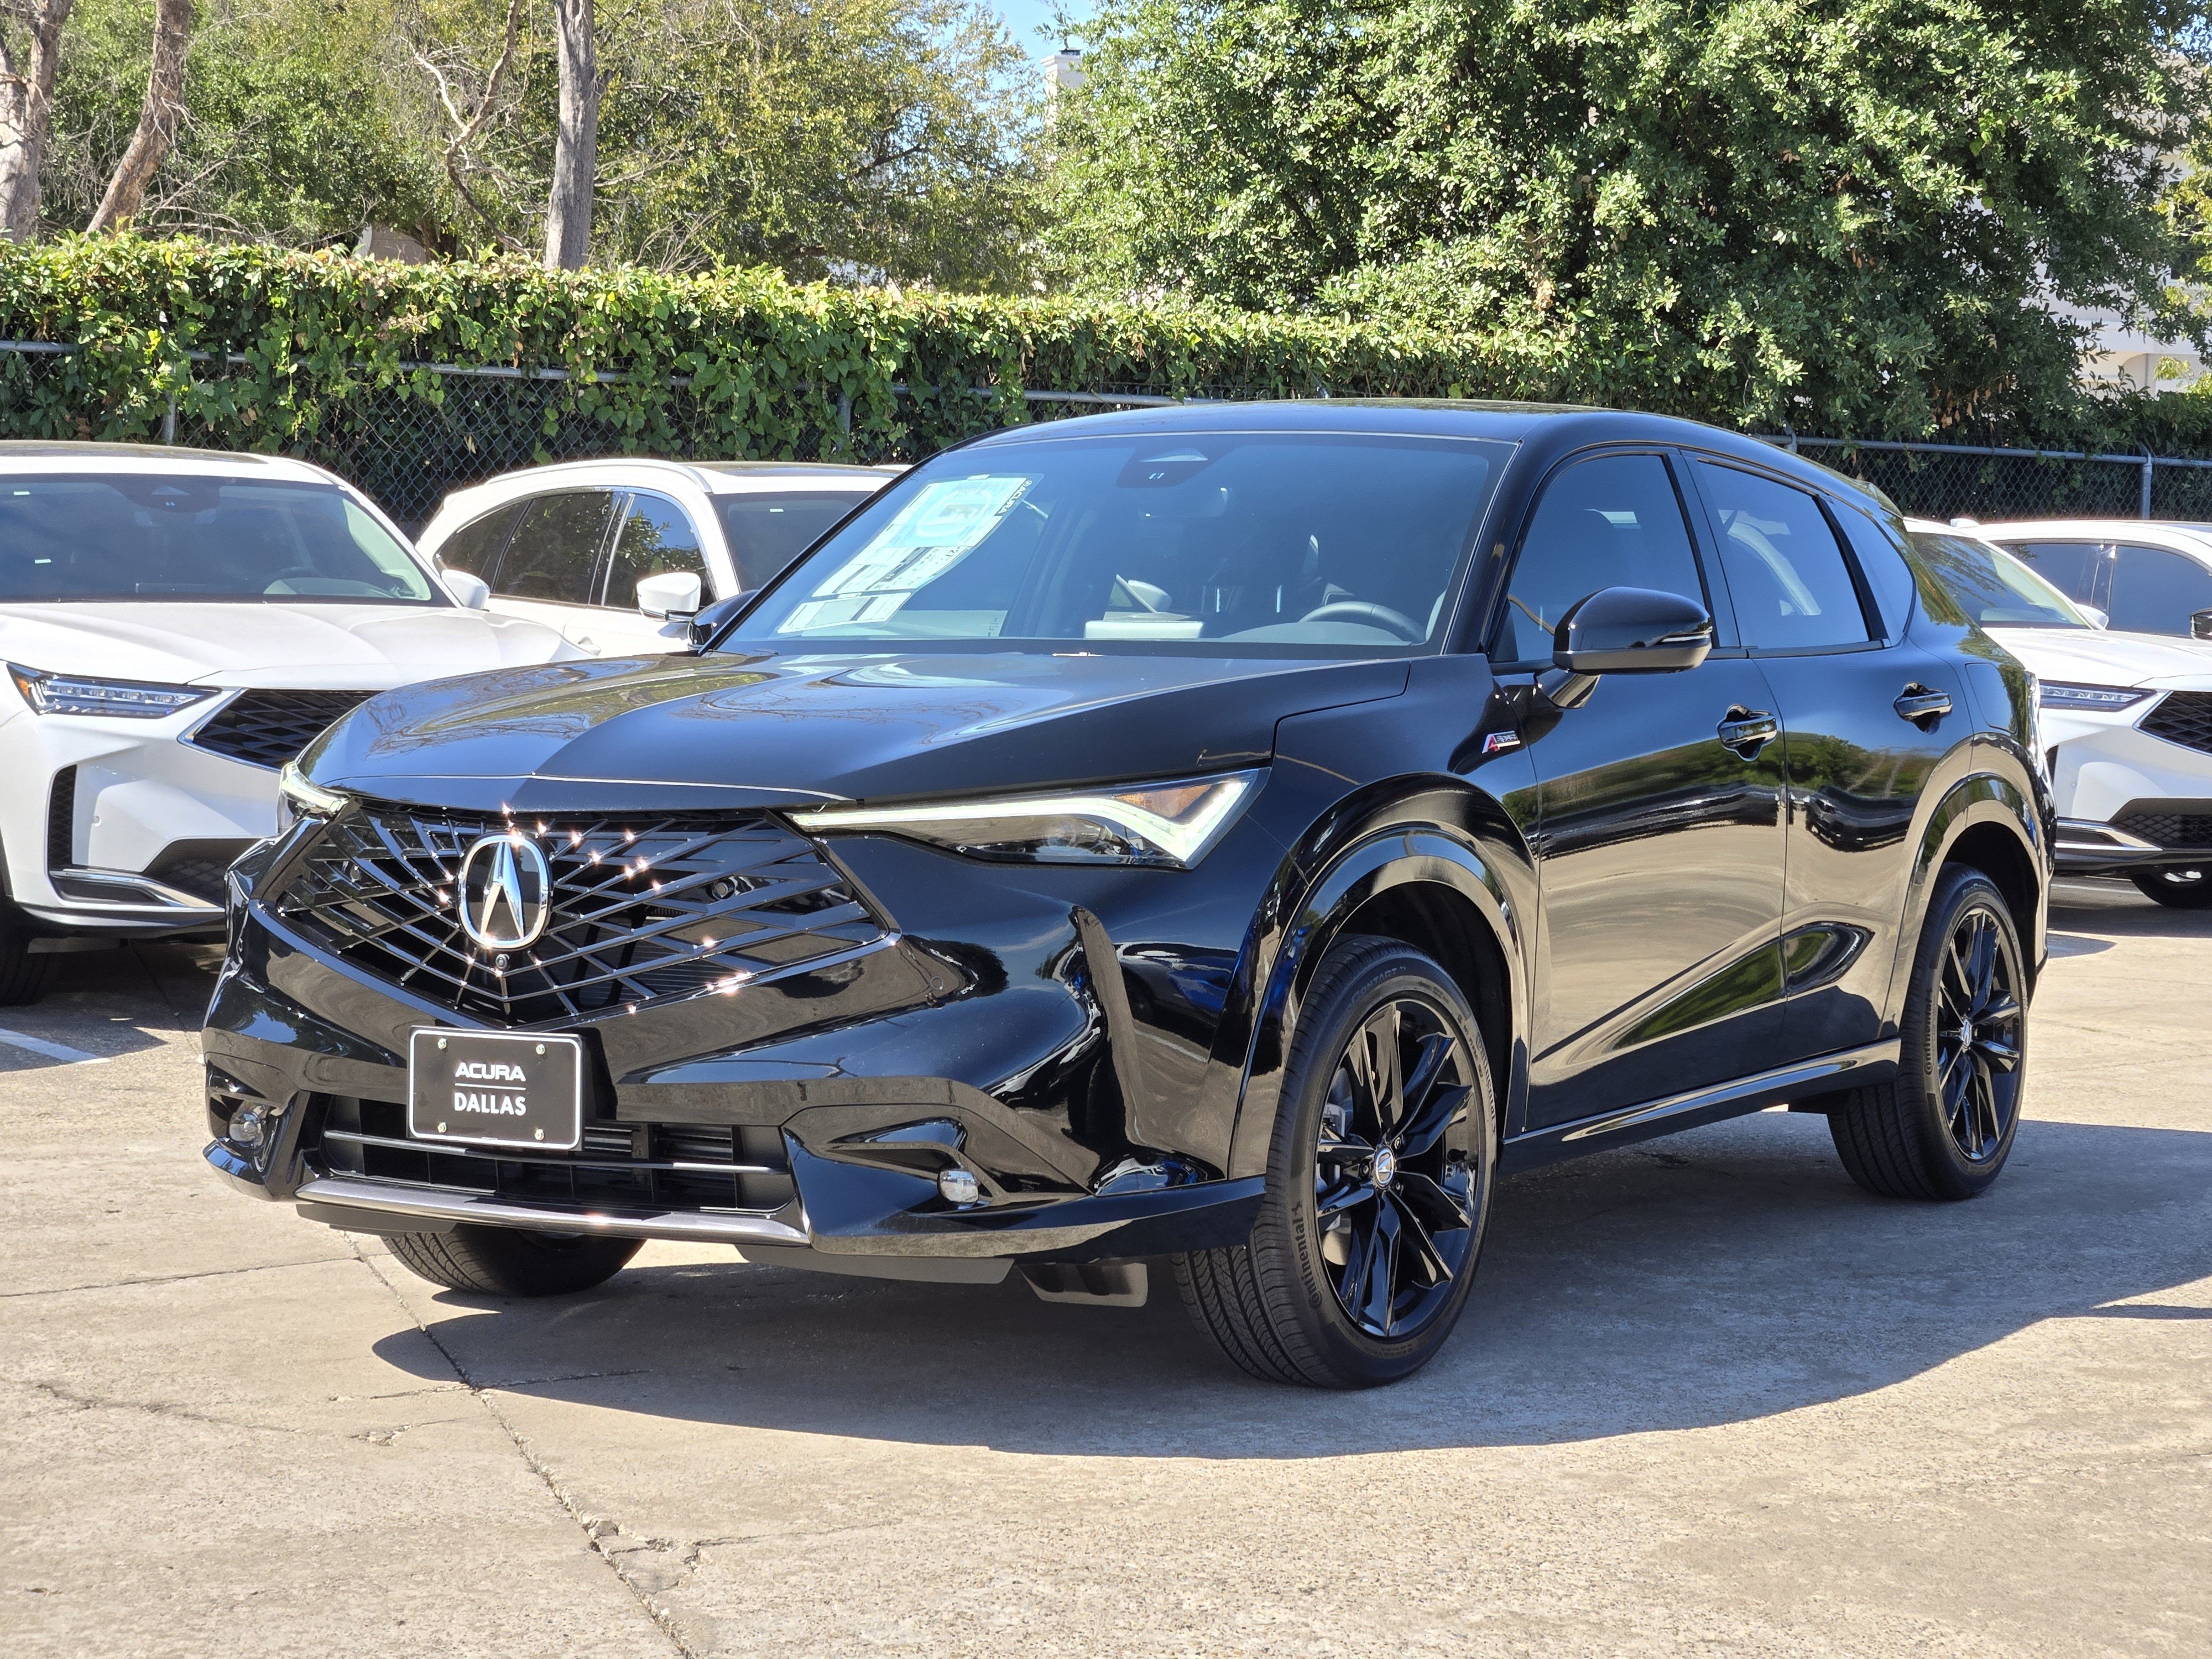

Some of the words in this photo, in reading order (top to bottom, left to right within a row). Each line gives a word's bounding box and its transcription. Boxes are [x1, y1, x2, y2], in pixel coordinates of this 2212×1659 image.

[998, 486, 1026, 514] ACURA
[455, 1062, 526, 1082] ACURA
[454, 1092, 526, 1116] DALLAS
[1292, 1218, 1323, 1310] Continental
